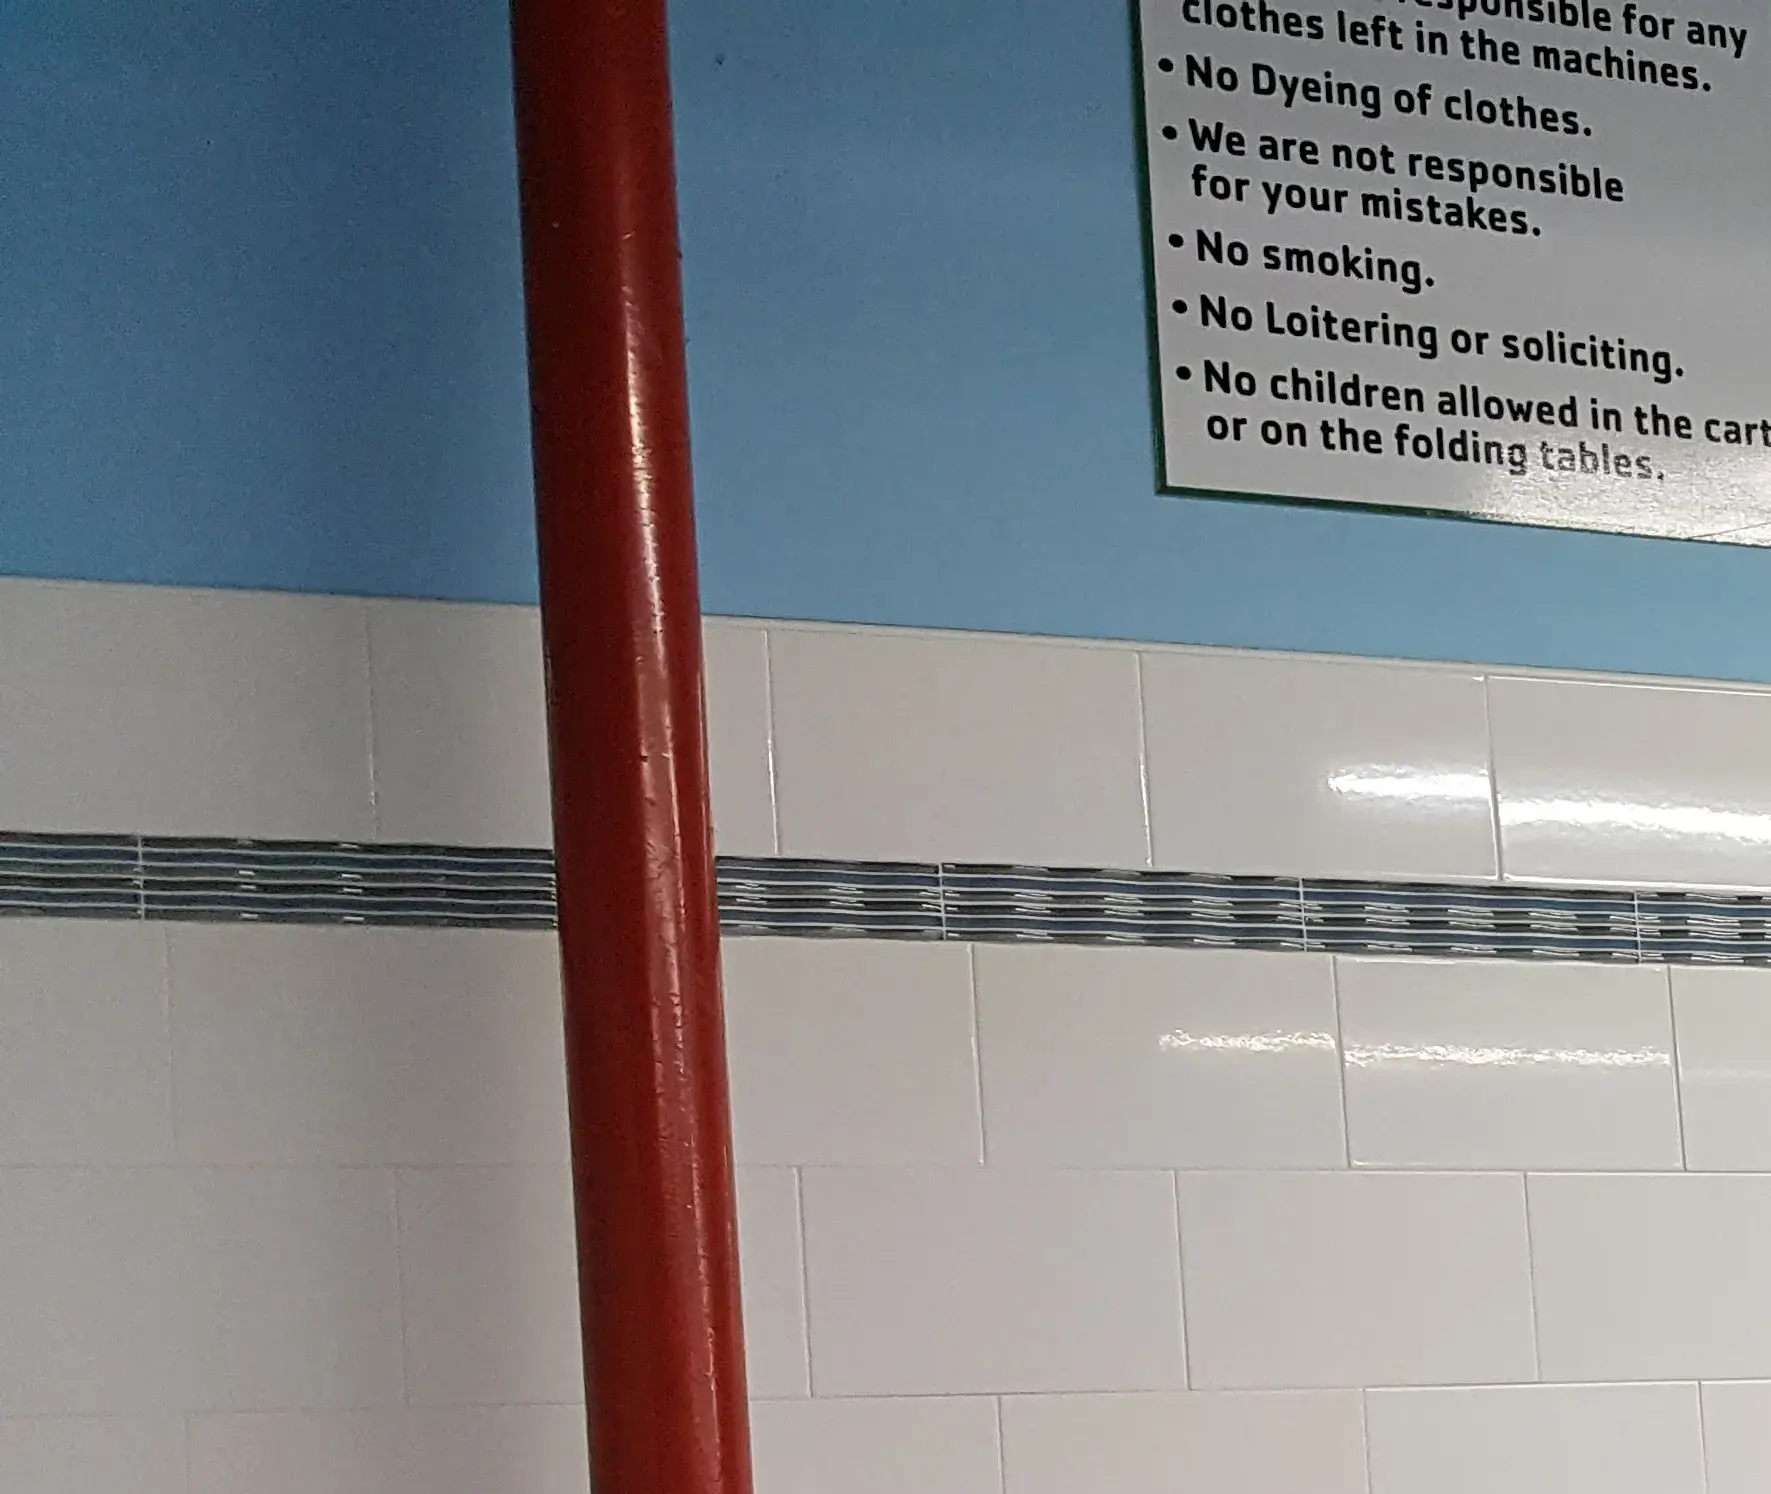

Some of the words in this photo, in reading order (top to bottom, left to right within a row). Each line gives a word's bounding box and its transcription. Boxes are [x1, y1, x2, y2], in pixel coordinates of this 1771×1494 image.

[1182, 0, 1323, 39] clothes
[1337, 10, 1403, 50] left
[1416, 20, 1448, 55] in
[1460, 29, 1520, 65] the
[1533, 46, 1711, 92] machines.
[1399, 0, 1611, 34] ponsible
[1623, 3, 1675, 40] for
[1687, 21, 1747, 59] any
[1186, 55, 1238, 91] No
[1252, 63, 1381, 119] Dyeing
[1395, 83, 1431, 115] of
[1445, 89, 1591, 136] clothes.
[1189, 118, 1245, 156] We
[1259, 136, 1319, 165] are
[1332, 145, 1395, 174] not
[1409, 154, 1624, 202] responsible
[1191, 164, 1250, 202] for
[1262, 182, 1348, 214] your
[1361, 188, 1541, 236] mistakes.
[1197, 229, 1248, 266] No
[1263, 245, 1434, 294] smoking.
[1200, 294, 1252, 331] No
[1266, 302, 1438, 359] Loitering
[1451, 329, 1489, 355] or
[1502, 330, 1683, 384] soliciting.
[1204, 360, 1256, 396] No
[1271, 367, 1424, 412] children
[1438, 384, 1578, 427] allowed
[1591, 398, 1622, 432] in
[1634, 404, 1692, 439] the
[1207, 415, 1247, 441] or
[1261, 420, 1307, 447] on
[1320, 418, 1382, 454] the
[1395, 423, 1527, 476] folding
[1540, 441, 1664, 484] tables.
